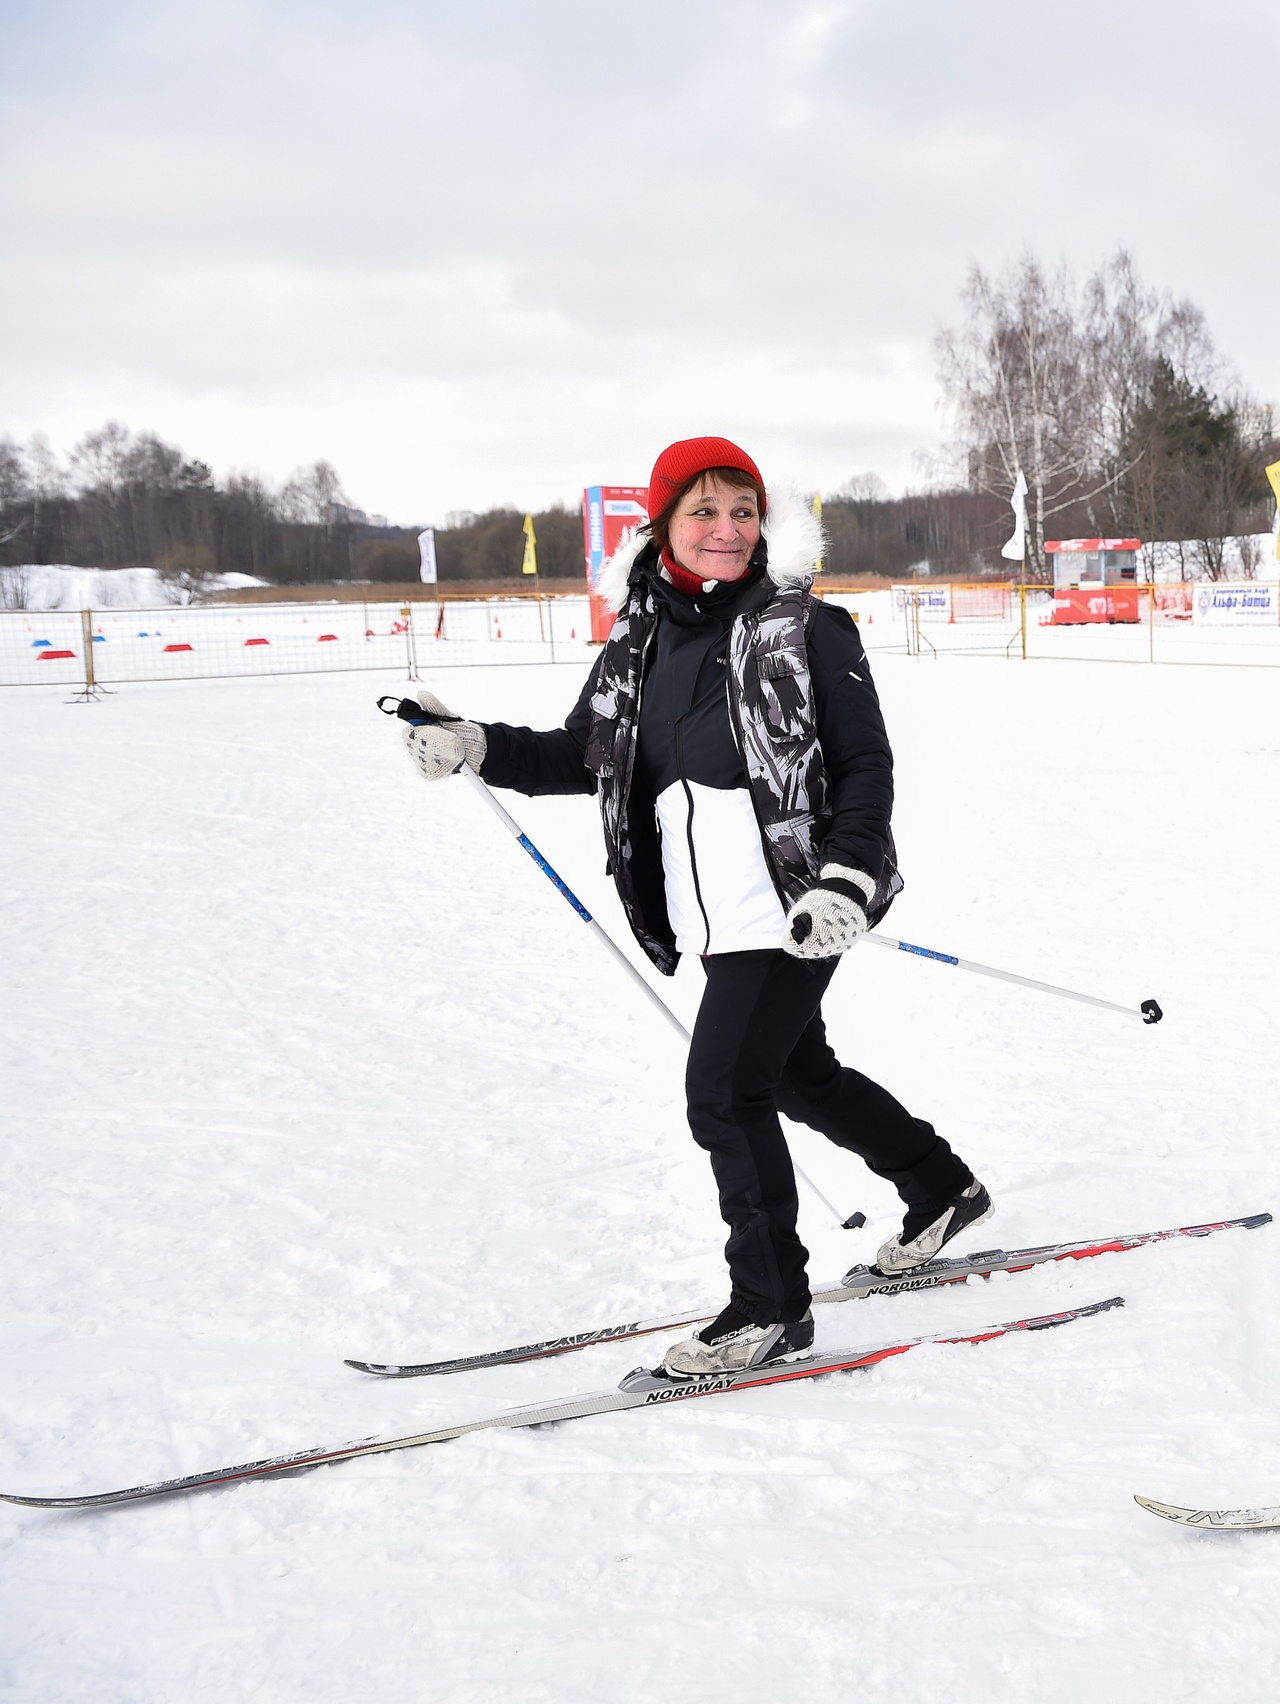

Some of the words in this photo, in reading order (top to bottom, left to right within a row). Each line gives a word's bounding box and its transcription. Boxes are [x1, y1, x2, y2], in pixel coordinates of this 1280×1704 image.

[866, 1275, 943, 1298] NORDWAY
[710, 1323, 756, 1346] FISCHER
[645, 1377, 738, 1403] NORDWAY
